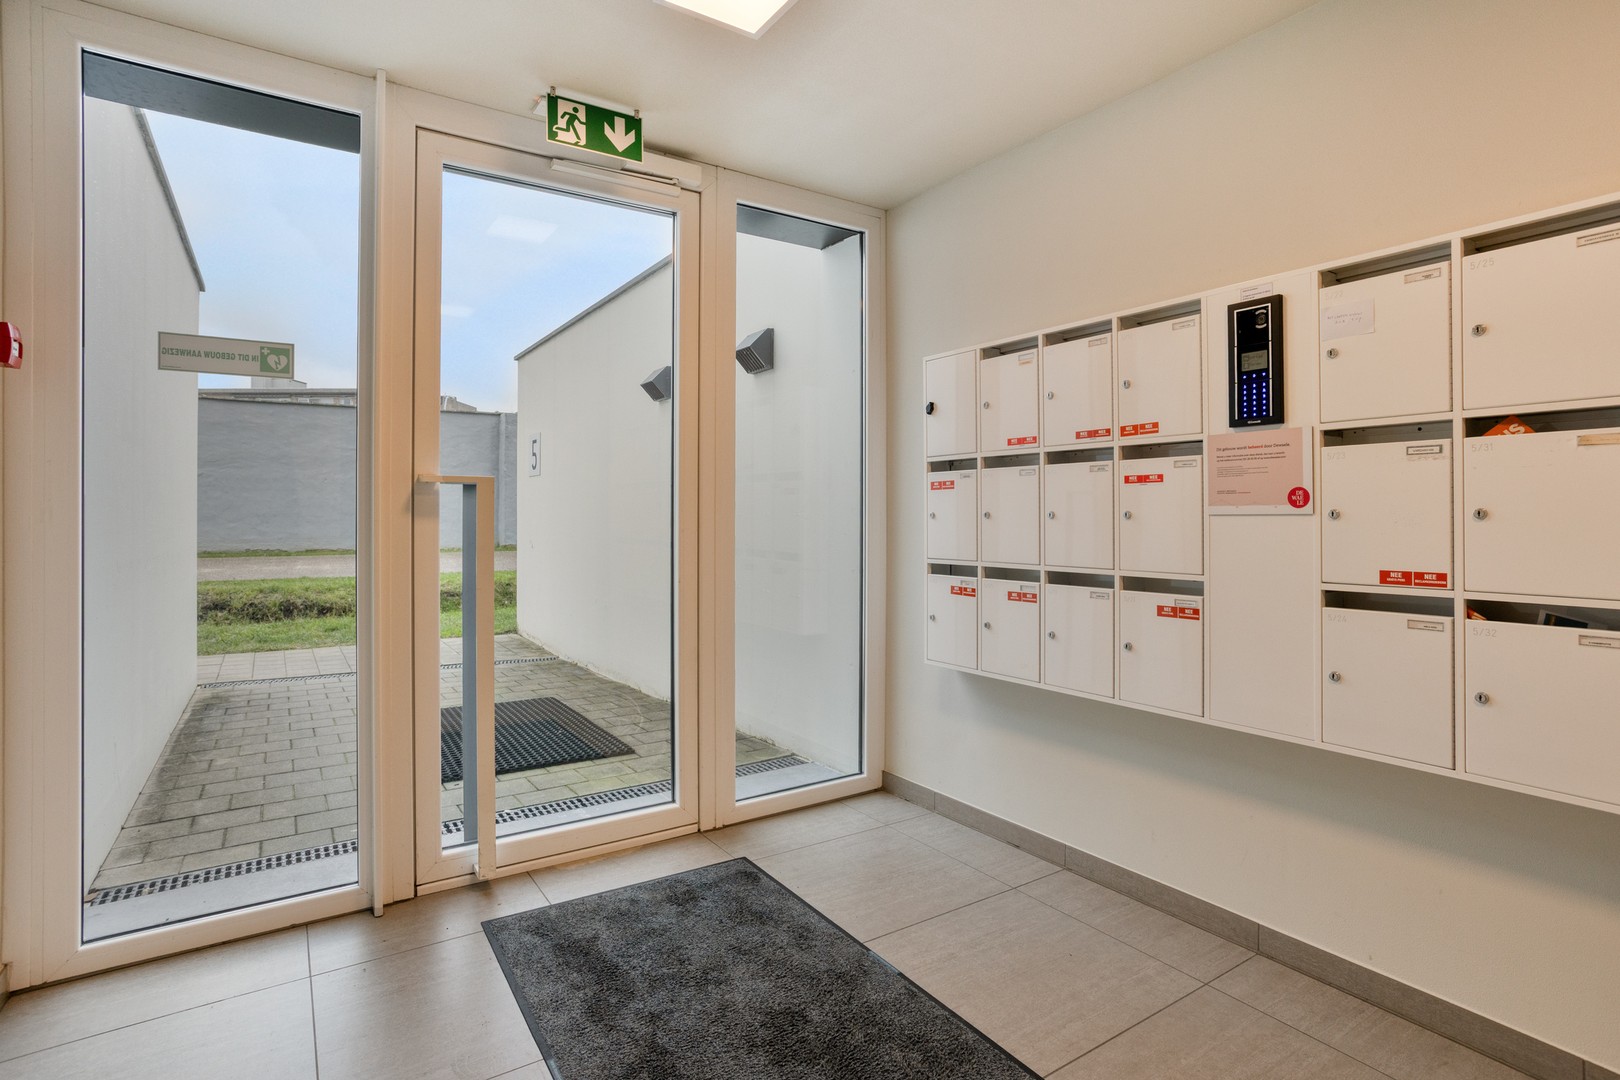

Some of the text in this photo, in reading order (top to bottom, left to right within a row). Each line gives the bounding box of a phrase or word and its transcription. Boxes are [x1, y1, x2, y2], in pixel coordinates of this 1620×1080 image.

[1470, 258, 1495, 270] 5/25
[531, 439, 538, 470] 5
[1473, 628, 1497, 638] 5/32
